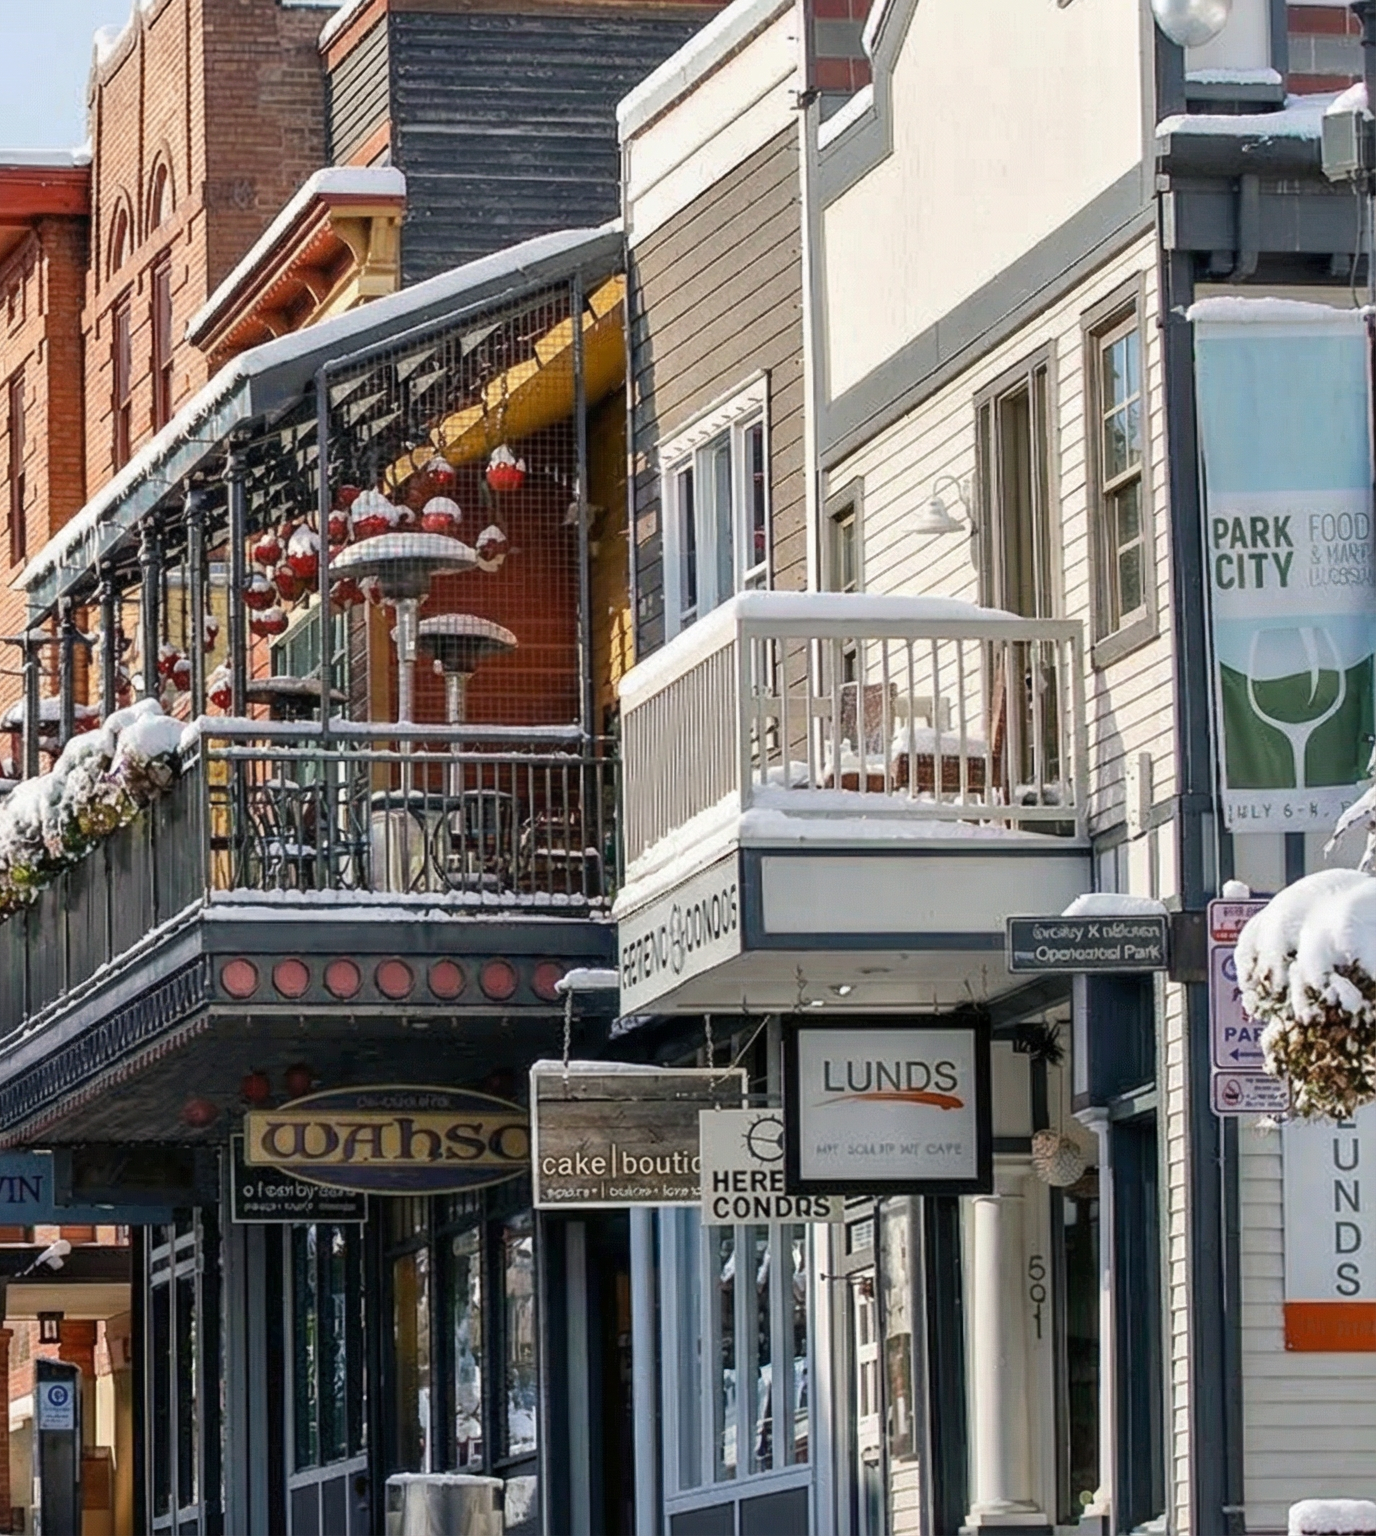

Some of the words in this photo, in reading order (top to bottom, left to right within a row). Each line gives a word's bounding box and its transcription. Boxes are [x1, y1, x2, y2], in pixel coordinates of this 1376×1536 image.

[1213, 515, 1293, 549] PARK
[1309, 512, 1369, 542] FOOD
[1215, 551, 1293, 589] CITY
[824, 1061, 958, 1092] LUNDS
[542, 1152, 606, 1175] cake
[713, 1170, 784, 1192] HERE
